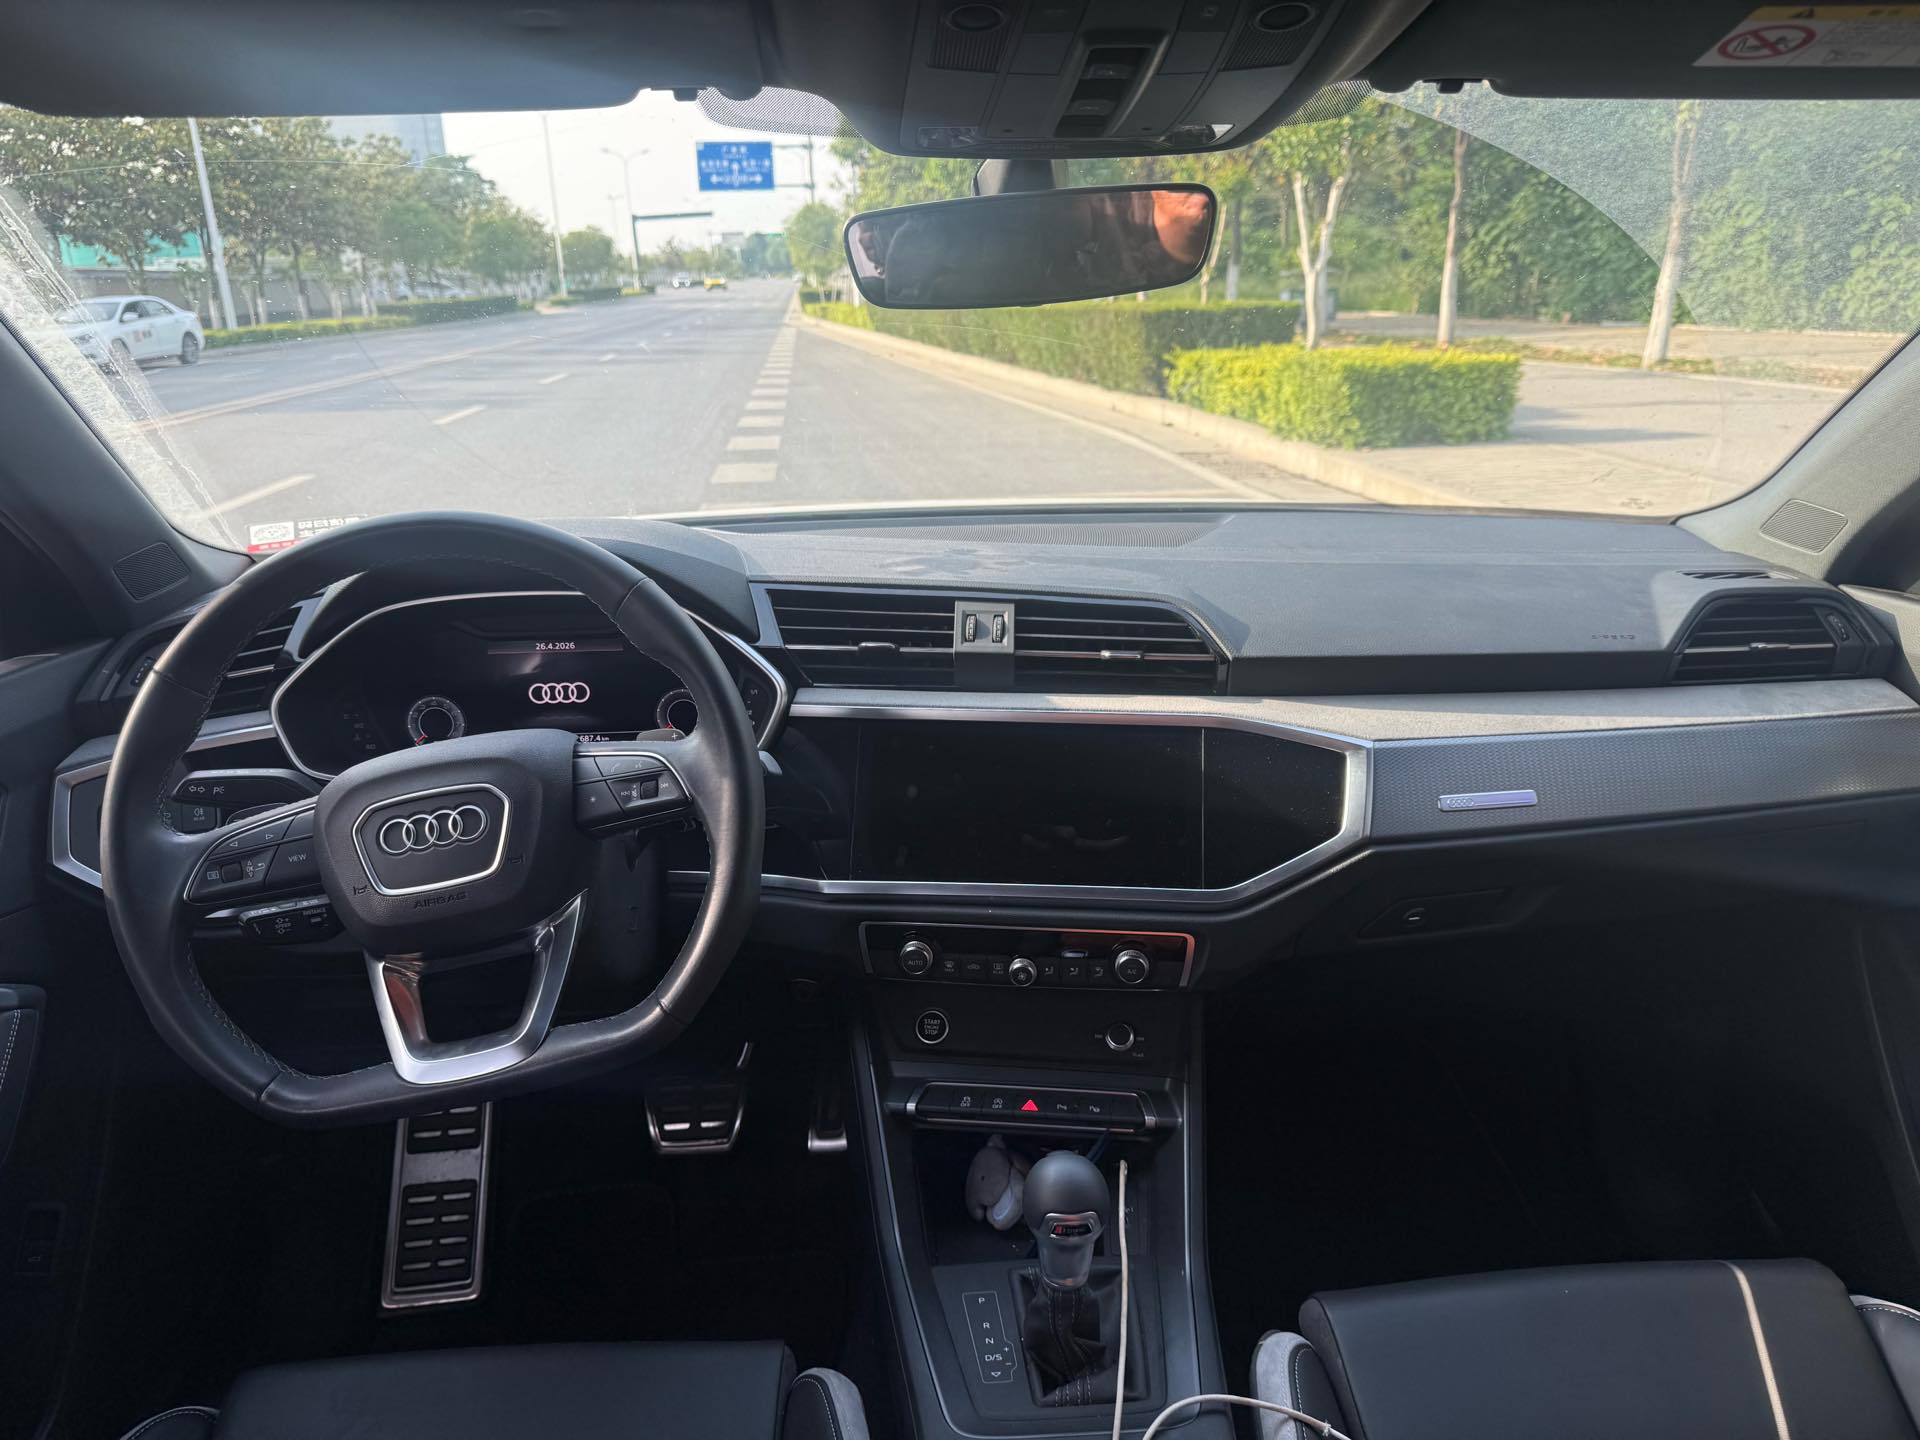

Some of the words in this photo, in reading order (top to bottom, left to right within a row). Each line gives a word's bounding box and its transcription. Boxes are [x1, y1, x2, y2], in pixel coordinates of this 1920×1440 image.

[535, 641, 576, 651] 26.4.2026
[288, 853, 307, 863] VIEW
[413, 892, 468, 910] AIRBAG
[985, 1337, 994, 1345] N
[984, 1353, 1003, 1361] D/S
